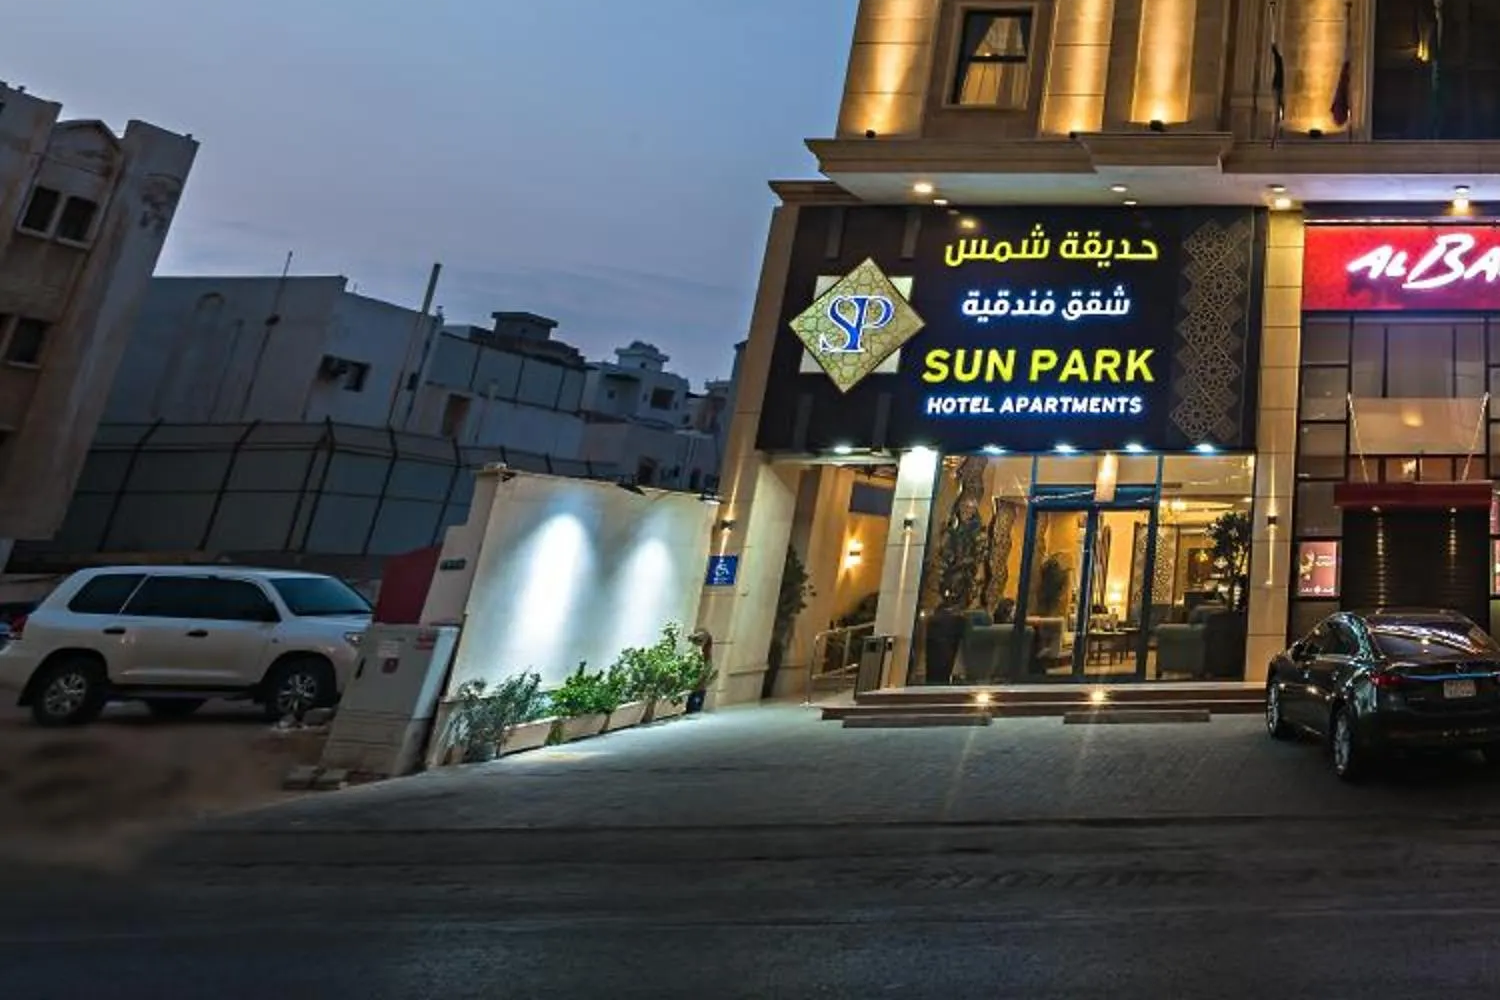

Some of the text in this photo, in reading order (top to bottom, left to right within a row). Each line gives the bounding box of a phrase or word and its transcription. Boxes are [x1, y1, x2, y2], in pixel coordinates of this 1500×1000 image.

[944, 223, 1158, 268] حديقة شمس
[961, 285, 1131, 323] شقق فندقية
[922, 348, 1155, 383] SUN PARK
[926, 396, 1143, 414] HOTEL APARTMENTS
